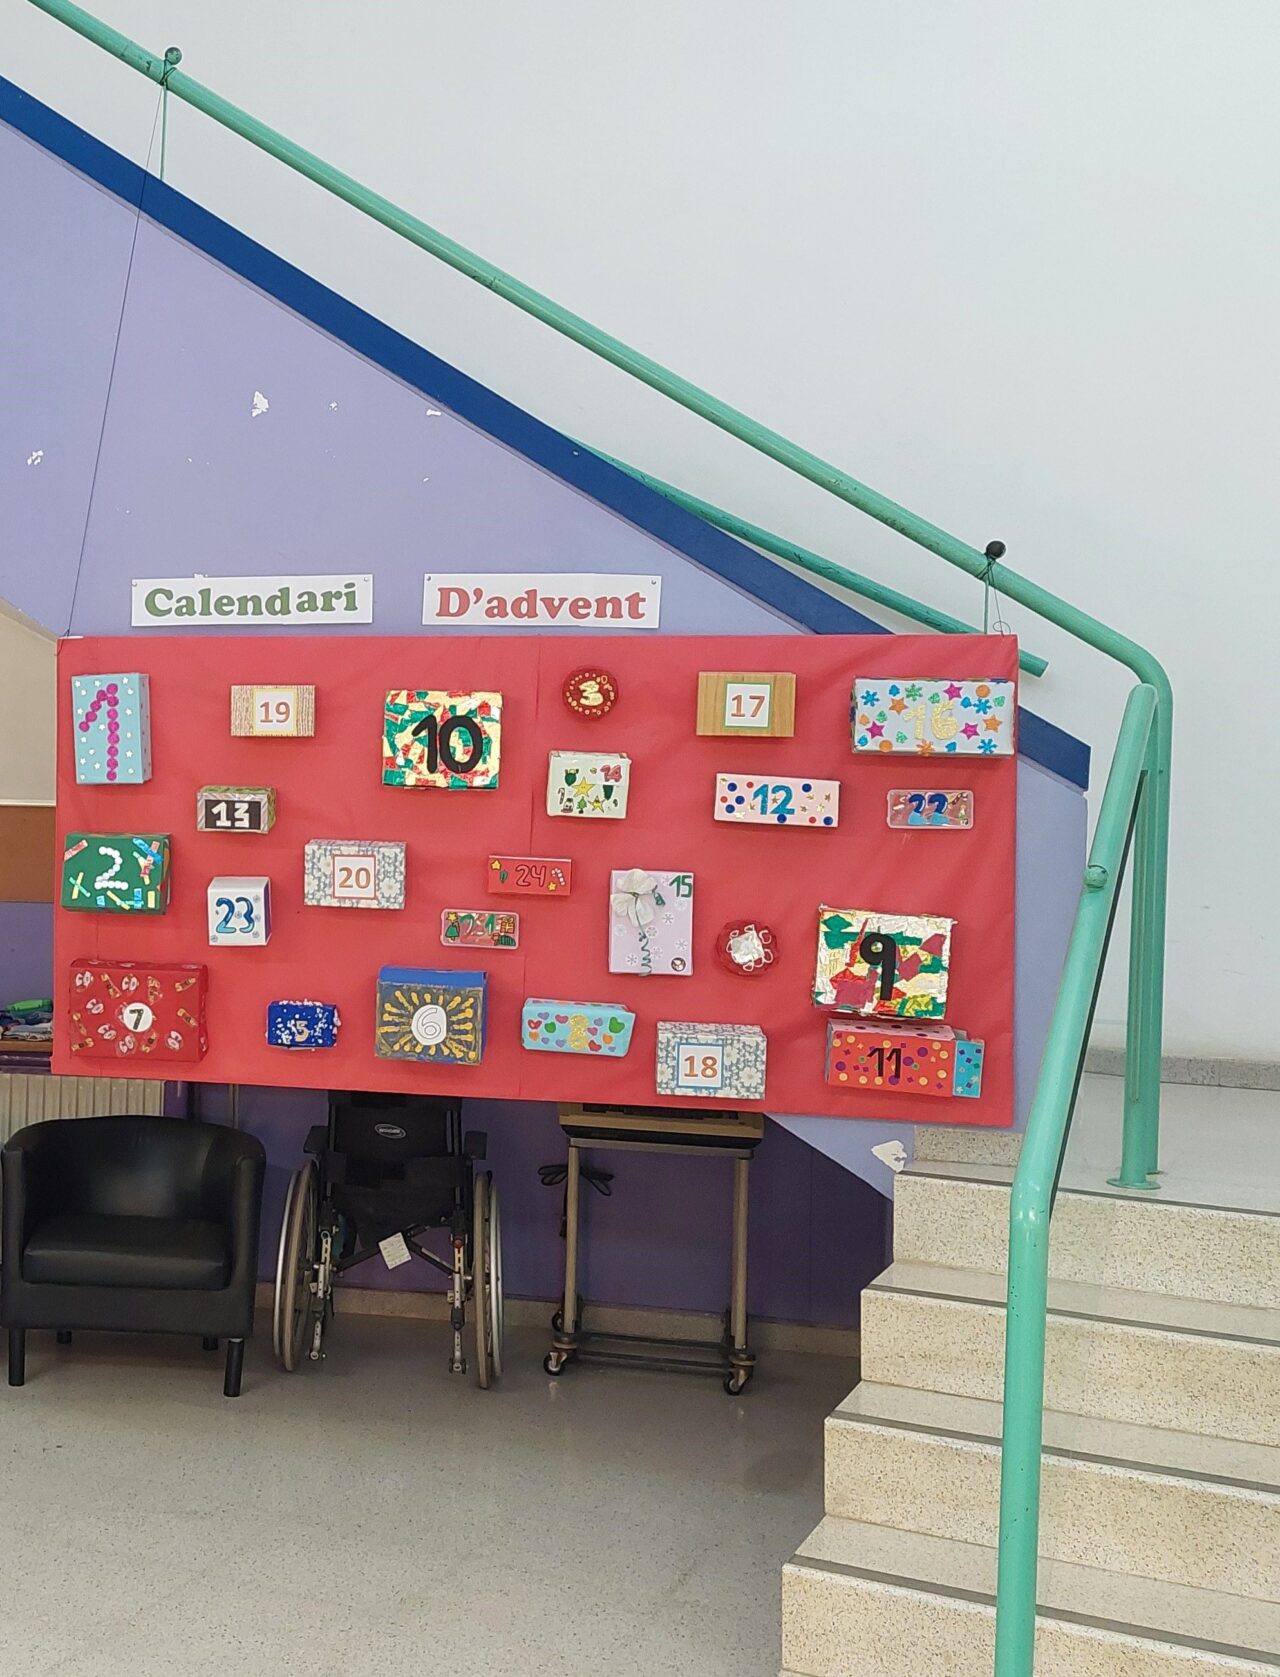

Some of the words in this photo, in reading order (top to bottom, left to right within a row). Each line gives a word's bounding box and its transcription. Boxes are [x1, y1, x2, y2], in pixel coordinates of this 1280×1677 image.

[144, 582, 358, 618] Calendari
[578, 680, 604, 706] 3
[730, 694, 766, 718] 17
[259, 701, 291, 724] 19
[903, 700, 959, 741] 16
[78, 683, 120, 782] 1
[411, 714, 483, 774] 10
[599, 764, 622, 783] 14
[212, 801, 251, 829] 13
[753, 783, 796, 816] 12
[907, 793, 950, 826] 22
[94, 846, 129, 890] 2
[338, 866, 371, 890] 20
[514, 864, 547, 888] 24
[669, 873, 692, 899] 15
[214, 896, 256, 934] 23
[459, 913, 496, 944] 21
[859, 933, 897, 1001] 9
[129, 1008, 144, 1031] 7
[294, 1020, 309, 1042] 5
[418, 1007, 439, 1039] 6
[567, 1014, 590, 1051] 8
[683, 1054, 718, 1077] 18
[867, 1047, 903, 1079] 11
